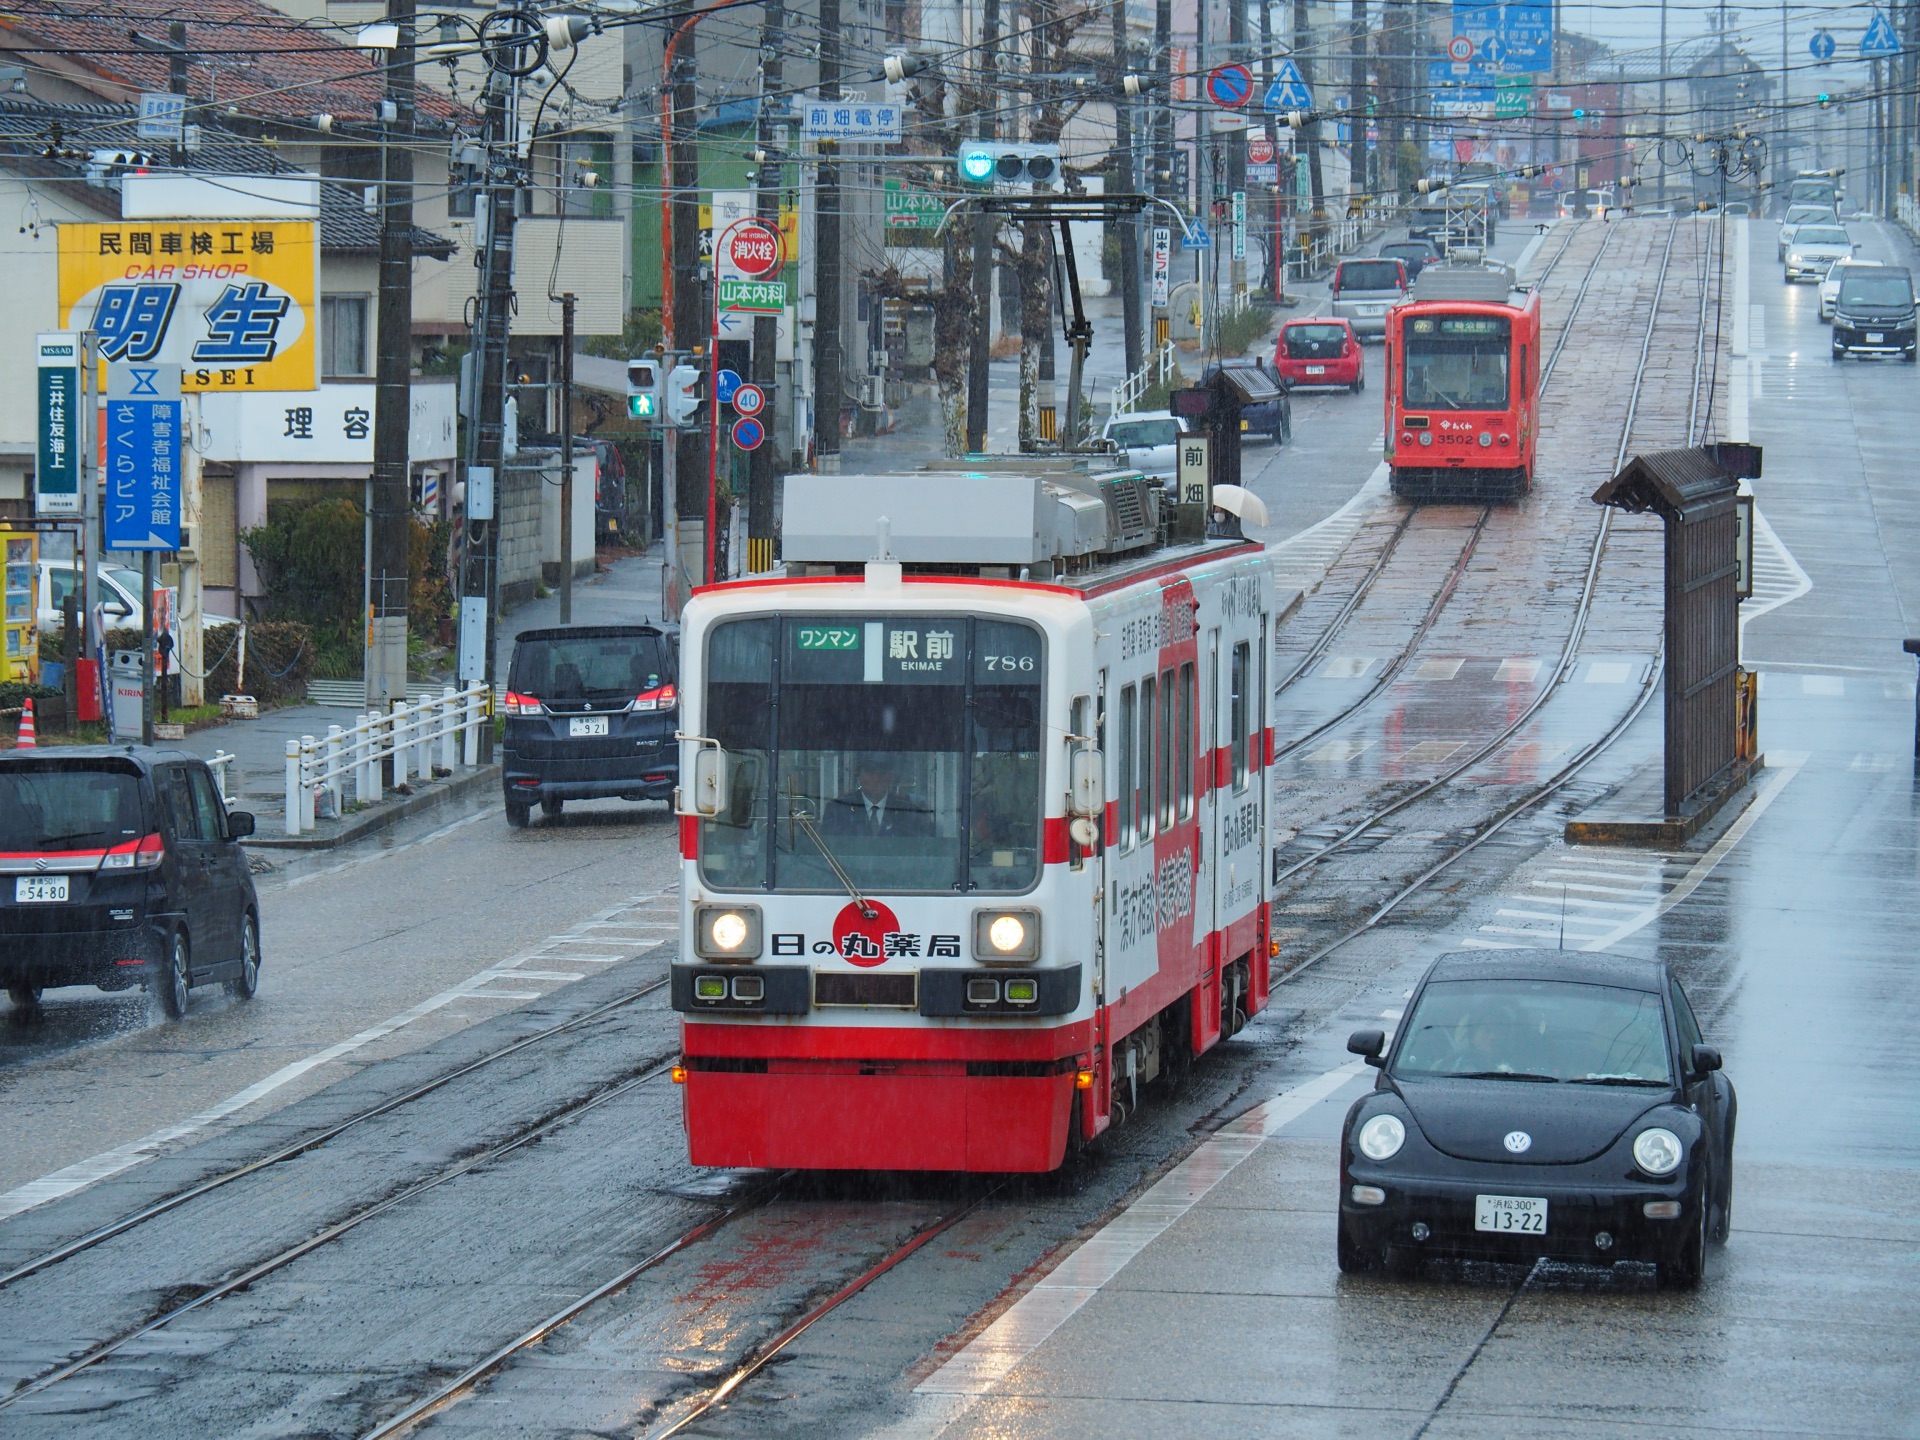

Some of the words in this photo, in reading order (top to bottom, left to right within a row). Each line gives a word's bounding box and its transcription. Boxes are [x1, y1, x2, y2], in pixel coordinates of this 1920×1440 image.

[1454, 43, 1468, 55] 40
[810, 108, 894, 126] 前畑電停
[98, 231, 275, 257] 民間車検工場
[733, 240, 774, 261] 消火栓
[124, 264, 176, 280] CAR
[182, 264, 249, 280] SHOP
[720, 282, 785, 306] 山本内科
[90, 282, 290, 363] 明生
[740, 392, 758, 408] 40
[49, 375, 66, 469] 三井住友海上
[284, 406, 370, 440] 理容
[1437, 434, 1474, 445] 3502
[115, 404, 136, 523] さくらピア
[151, 404, 172, 525] 障害者福祉会館
[1184, 446, 1204, 503] 前畑
[800, 630, 858, 647] ワンマン
[889, 630, 953, 661] 駅前
[901, 661, 943, 672] EKIMAE
[983, 655, 1035, 672] 786
[28, 886, 66, 900] 54-80
[771, 932, 962, 958] 日の丸薬局
[1493, 1199, 1532, 1211] 浜松300
[1480, 1215, 1488, 1225] と
[1494, 1211, 1543, 1231] 13-22
